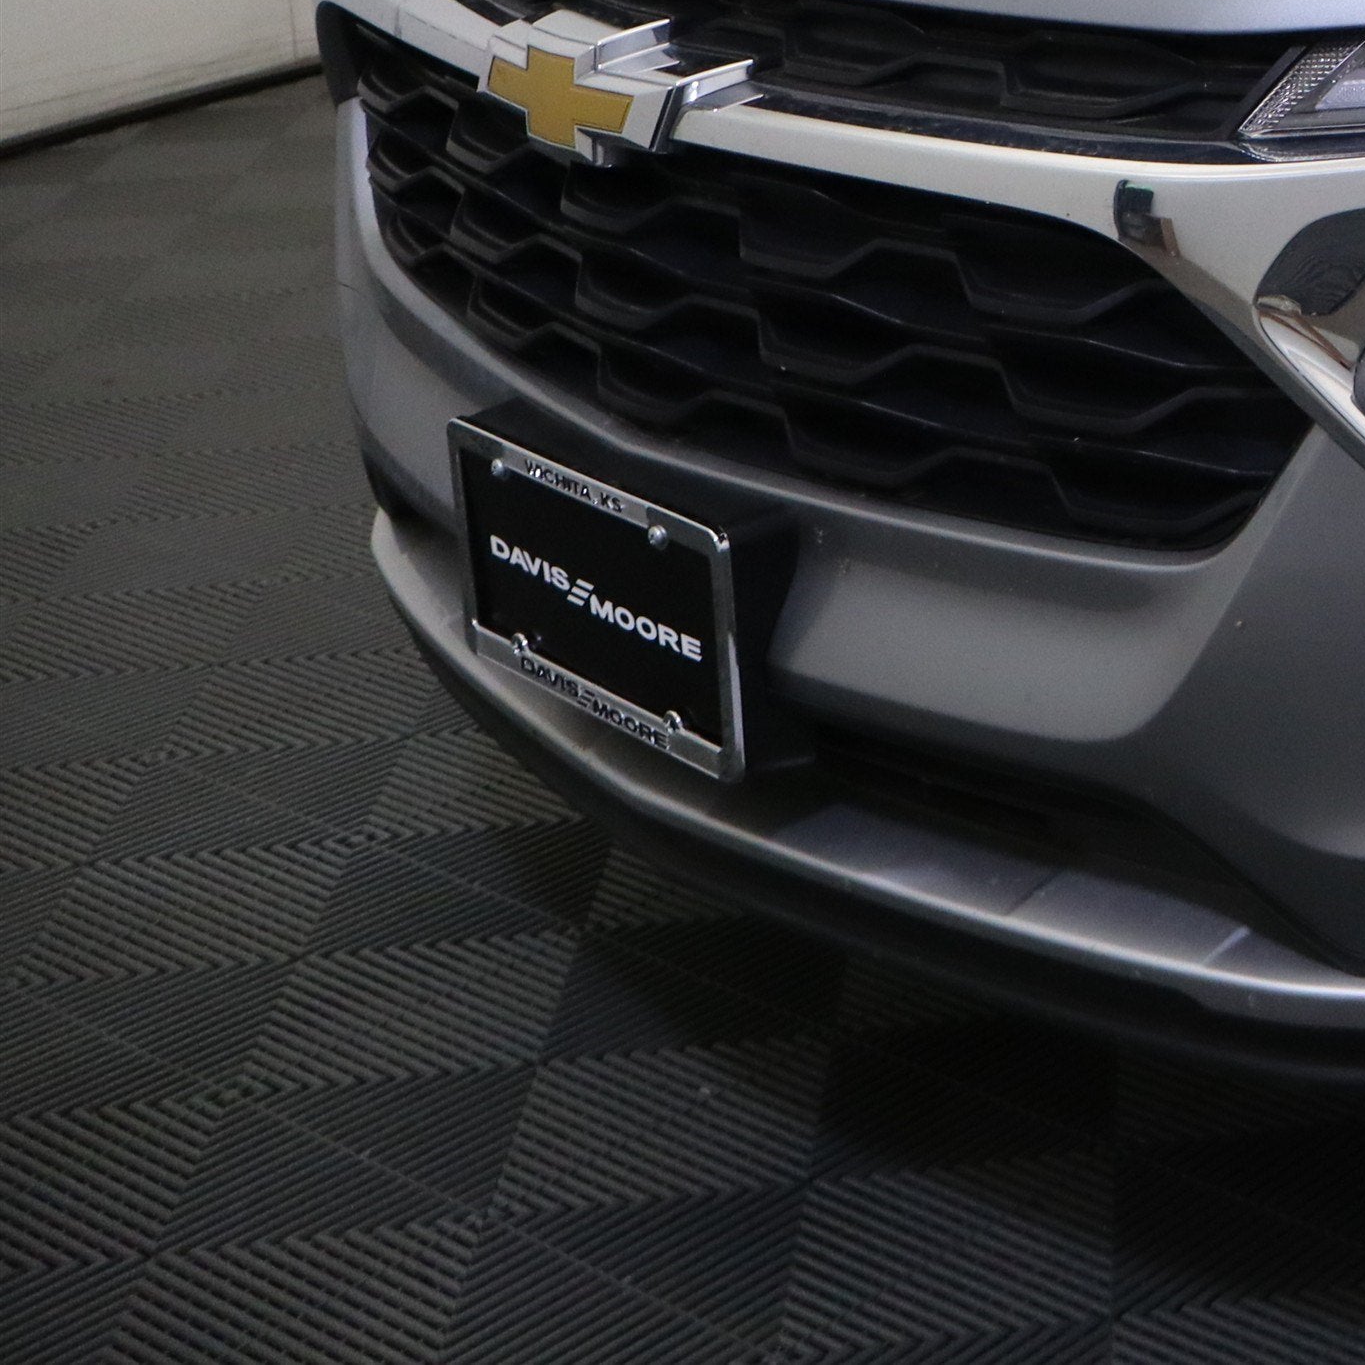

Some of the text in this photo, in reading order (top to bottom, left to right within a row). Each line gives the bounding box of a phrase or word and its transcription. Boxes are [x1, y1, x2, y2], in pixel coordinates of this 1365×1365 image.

[600, 491, 622, 513] KS
[489, 534, 703, 663] DAVIS MOORE
[521, 657, 670, 750] DAVIS MOORE
